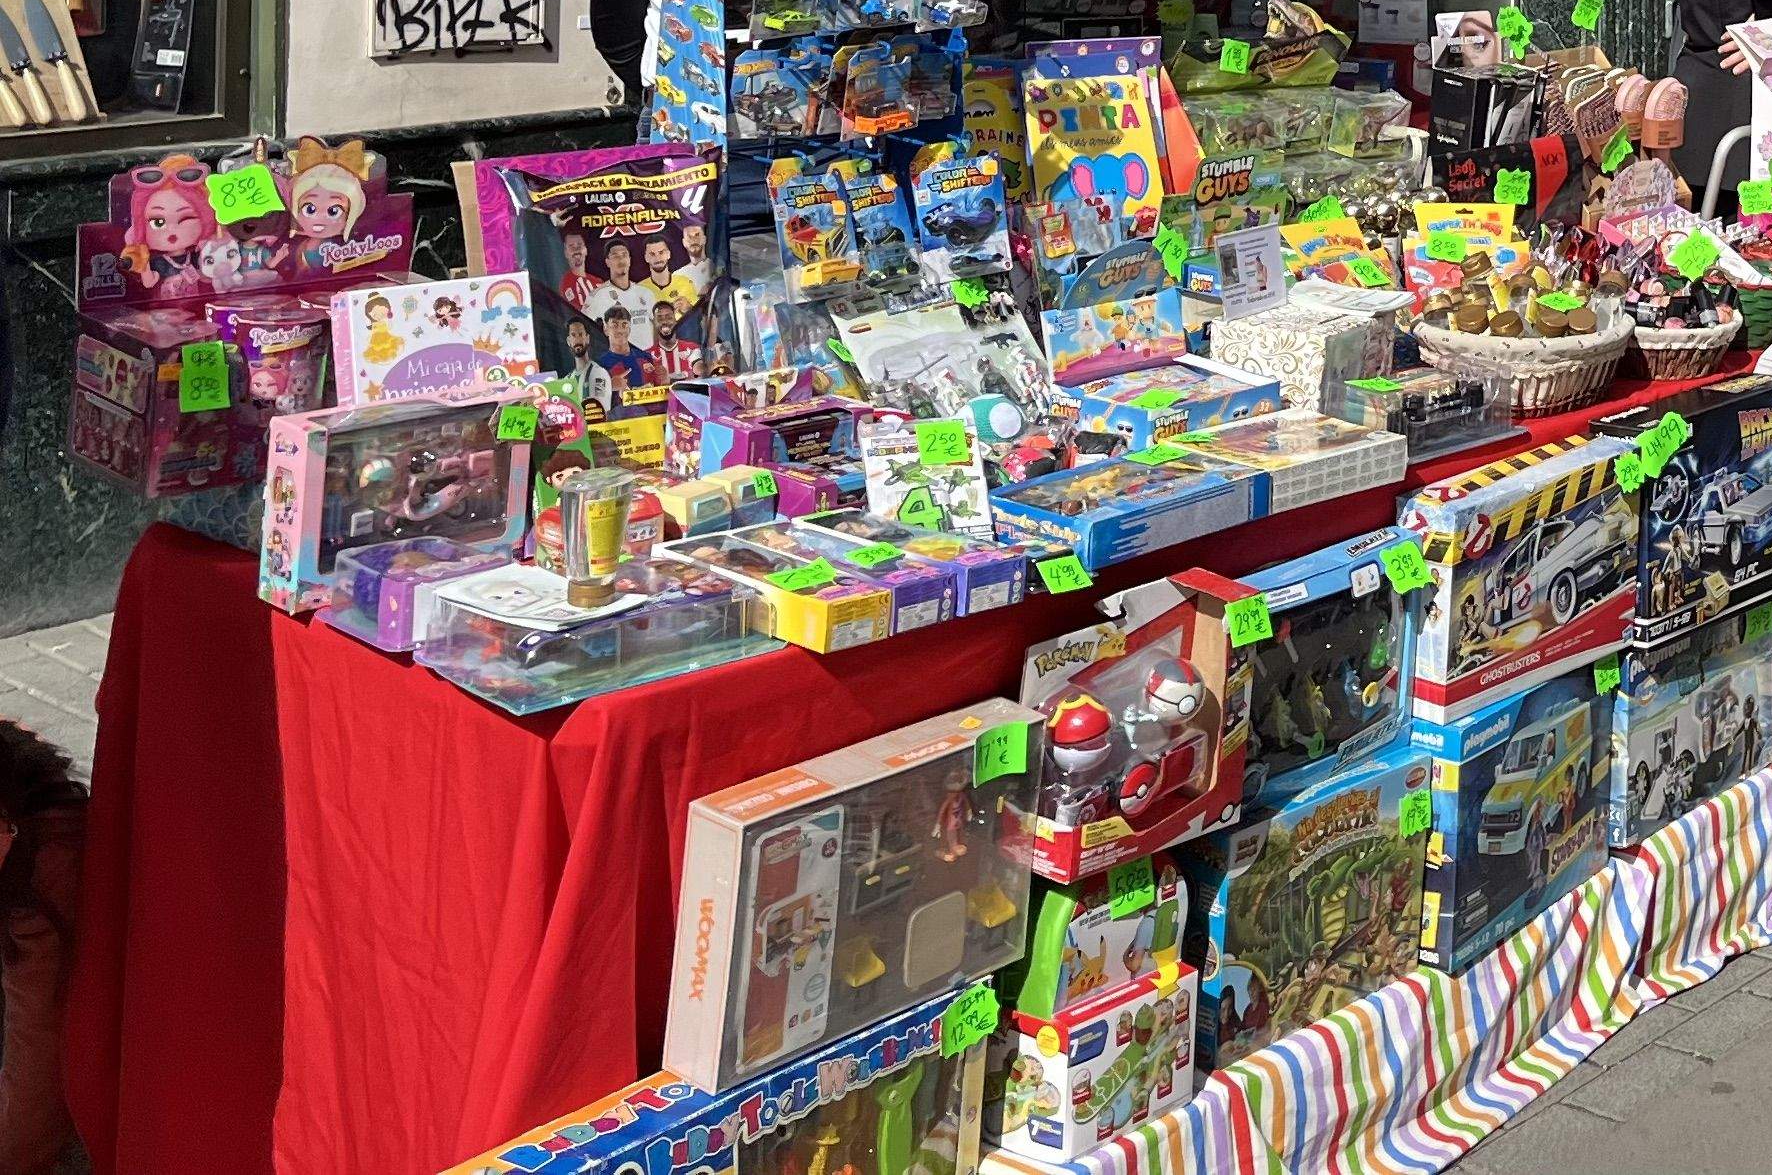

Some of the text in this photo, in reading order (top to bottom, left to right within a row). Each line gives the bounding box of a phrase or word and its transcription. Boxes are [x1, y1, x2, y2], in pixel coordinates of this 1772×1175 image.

[1200, 156, 1254, 176] STUMBLE
[1196, 172, 1251, 206] GUYS
[581, 208, 681, 228] ADRENALYN
[407, 360, 430, 380] Mi
[435, 361, 464, 376] caja
[1480, 651, 1541, 685] GHOSTBUSTERS
[1463, 714, 1511, 756] playmobil
